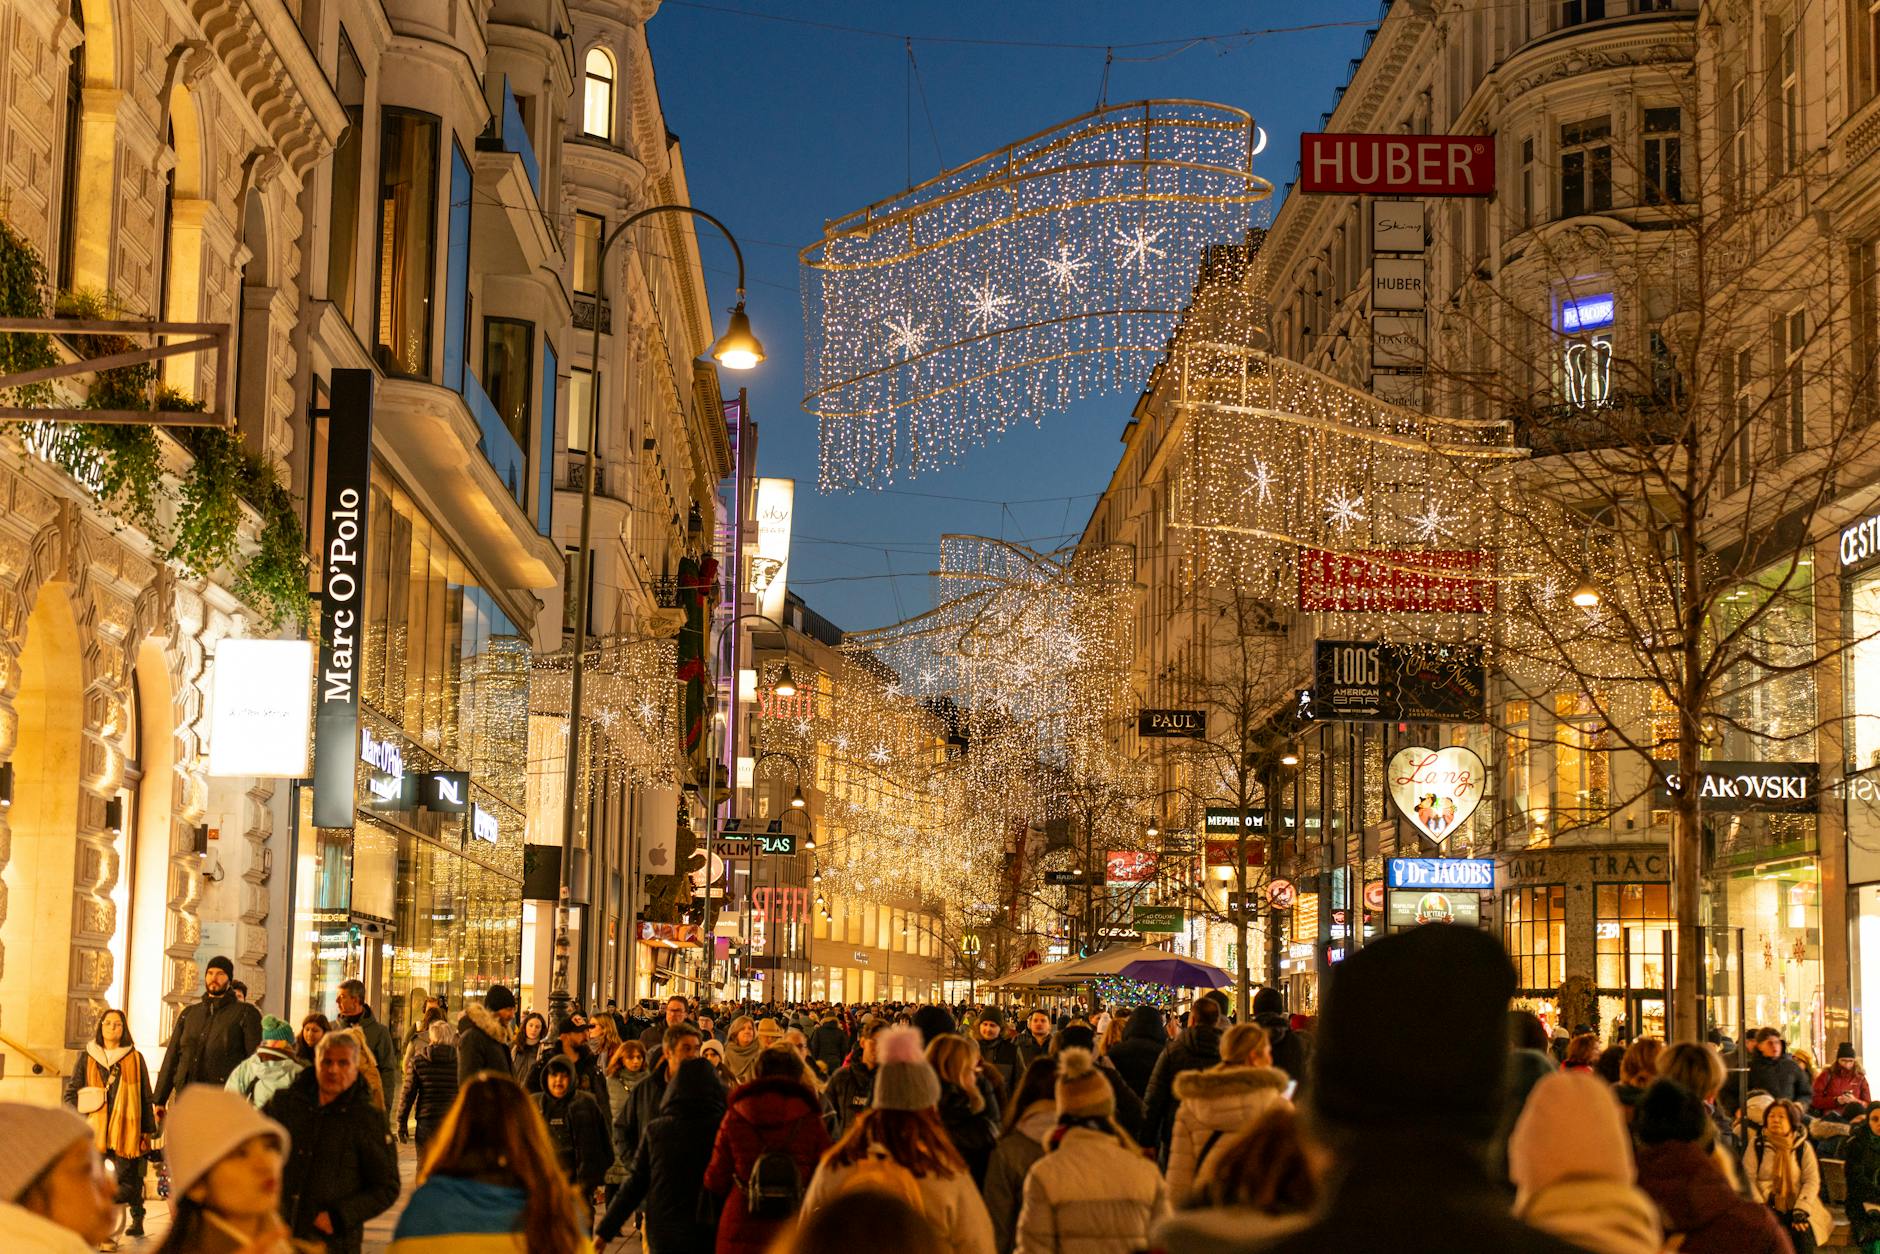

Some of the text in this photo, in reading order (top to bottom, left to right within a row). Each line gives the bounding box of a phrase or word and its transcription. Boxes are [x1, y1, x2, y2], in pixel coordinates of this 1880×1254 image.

[1376, 277, 1421, 291] HUBER
[1377, 335, 1420, 346] HANRO
[324, 609, 354, 704] Marc
[1333, 647, 1380, 686] LOOS
[1333, 688, 1380, 697] AMERICAN
[1333, 696, 1380, 706] BAR
[1151, 713, 1197, 728] PAUL
[1396, 753, 1475, 797] Lanz
[1407, 861, 1492, 886] Dr JACOBS
[1508, 859, 1547, 880] LANZ
[752, 886, 812, 924] STEFFL
